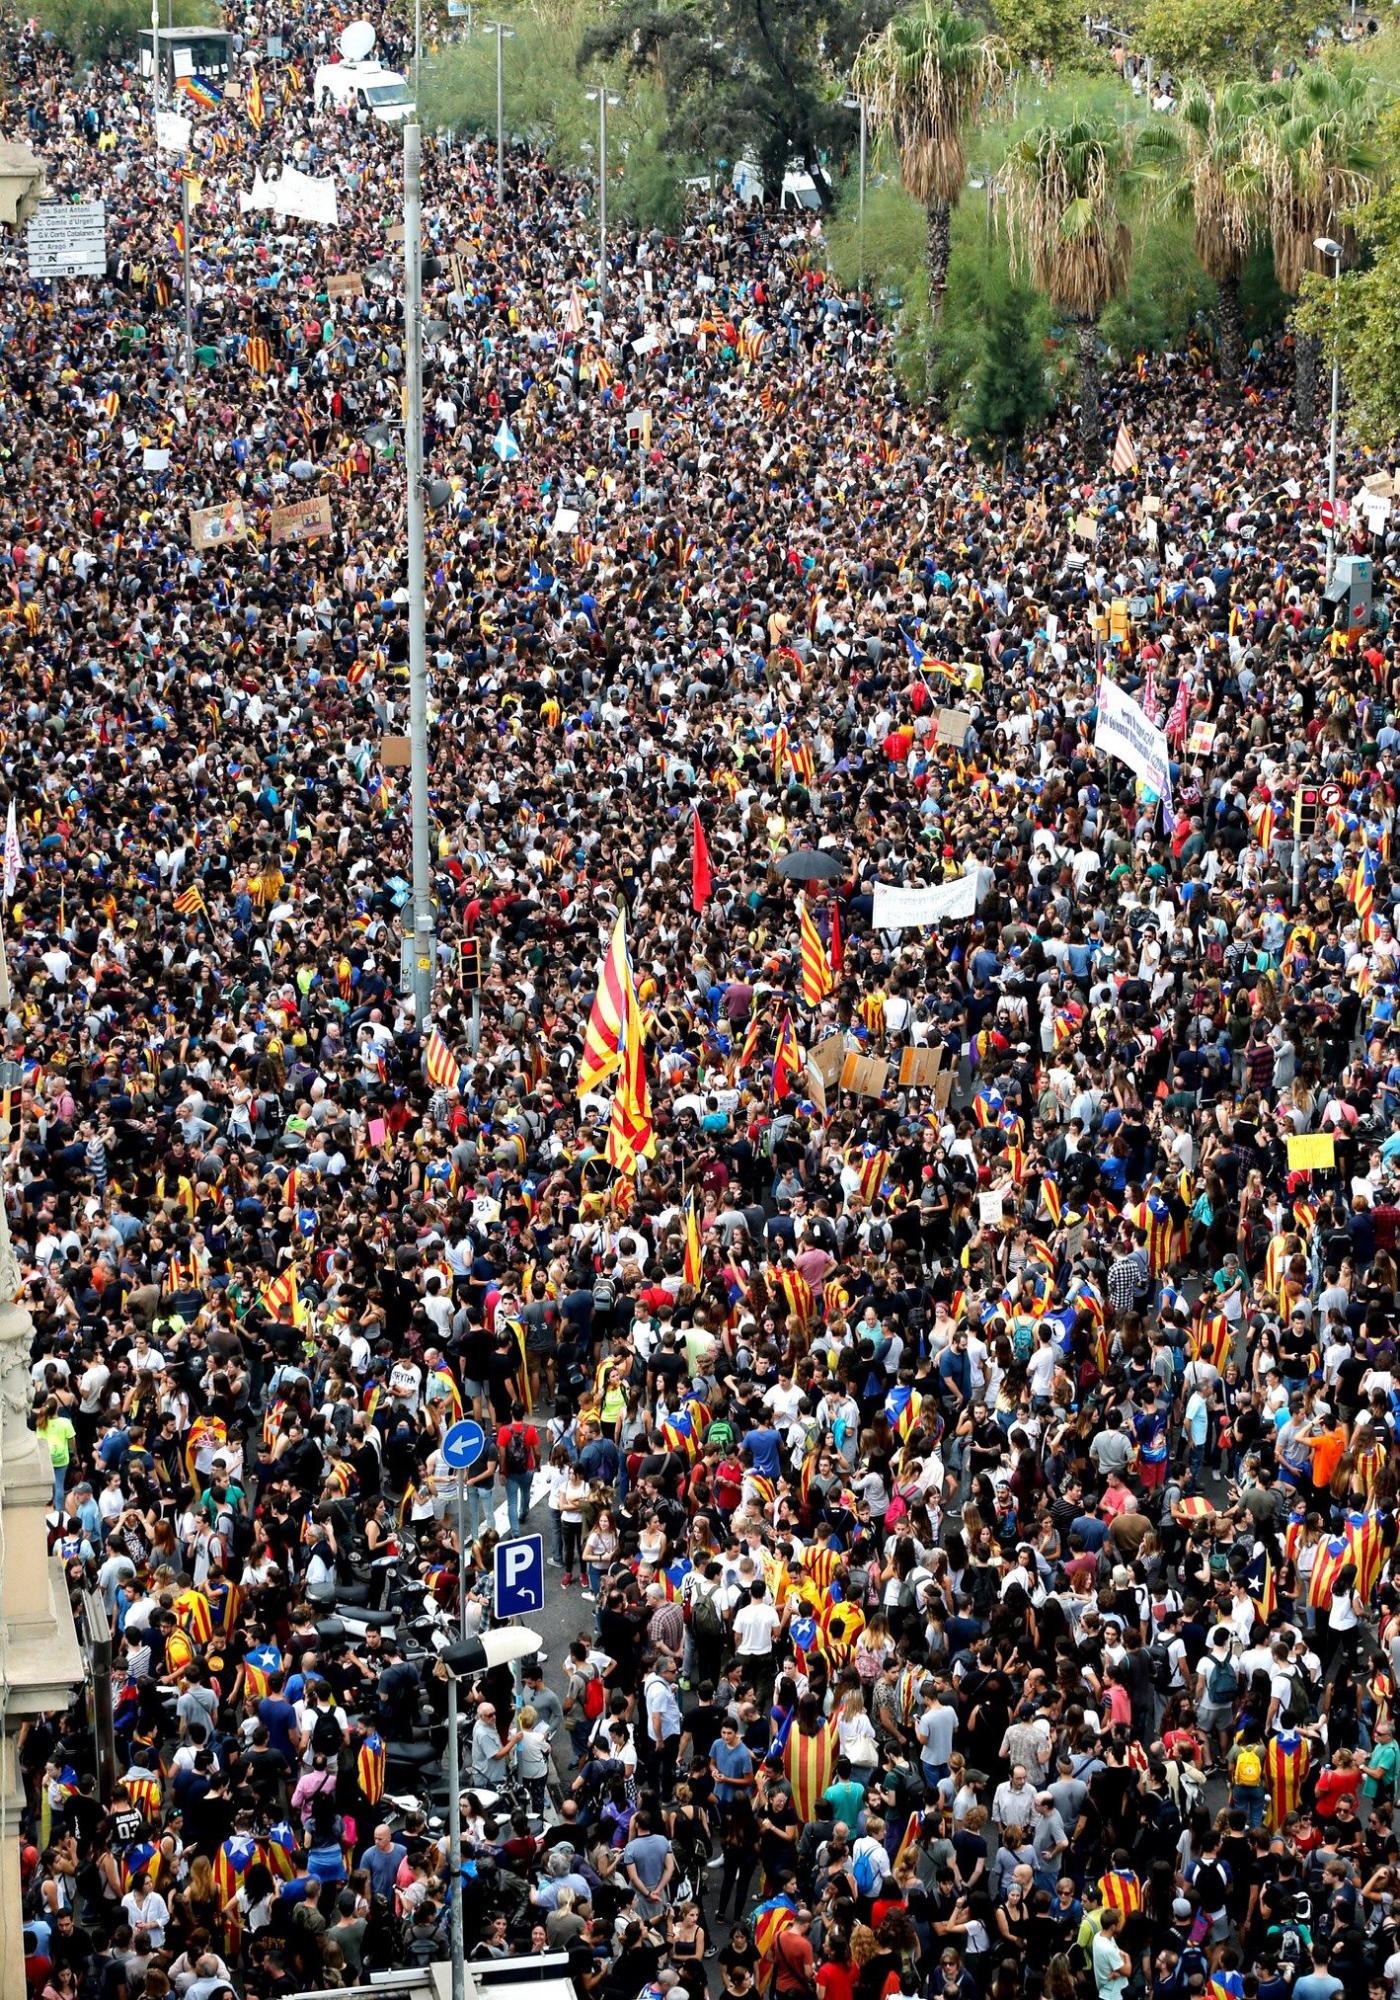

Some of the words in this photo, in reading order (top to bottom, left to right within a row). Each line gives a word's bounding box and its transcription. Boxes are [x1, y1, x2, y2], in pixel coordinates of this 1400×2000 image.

[53, 206, 68, 214] Sant
[38, 219, 45, 227] C.
[68, 217, 95, 226] d'Urgell
[66, 230, 95, 238] Catalanes
[40, 266, 66, 275] Aeroport
[505, 1544, 535, 1588] P
